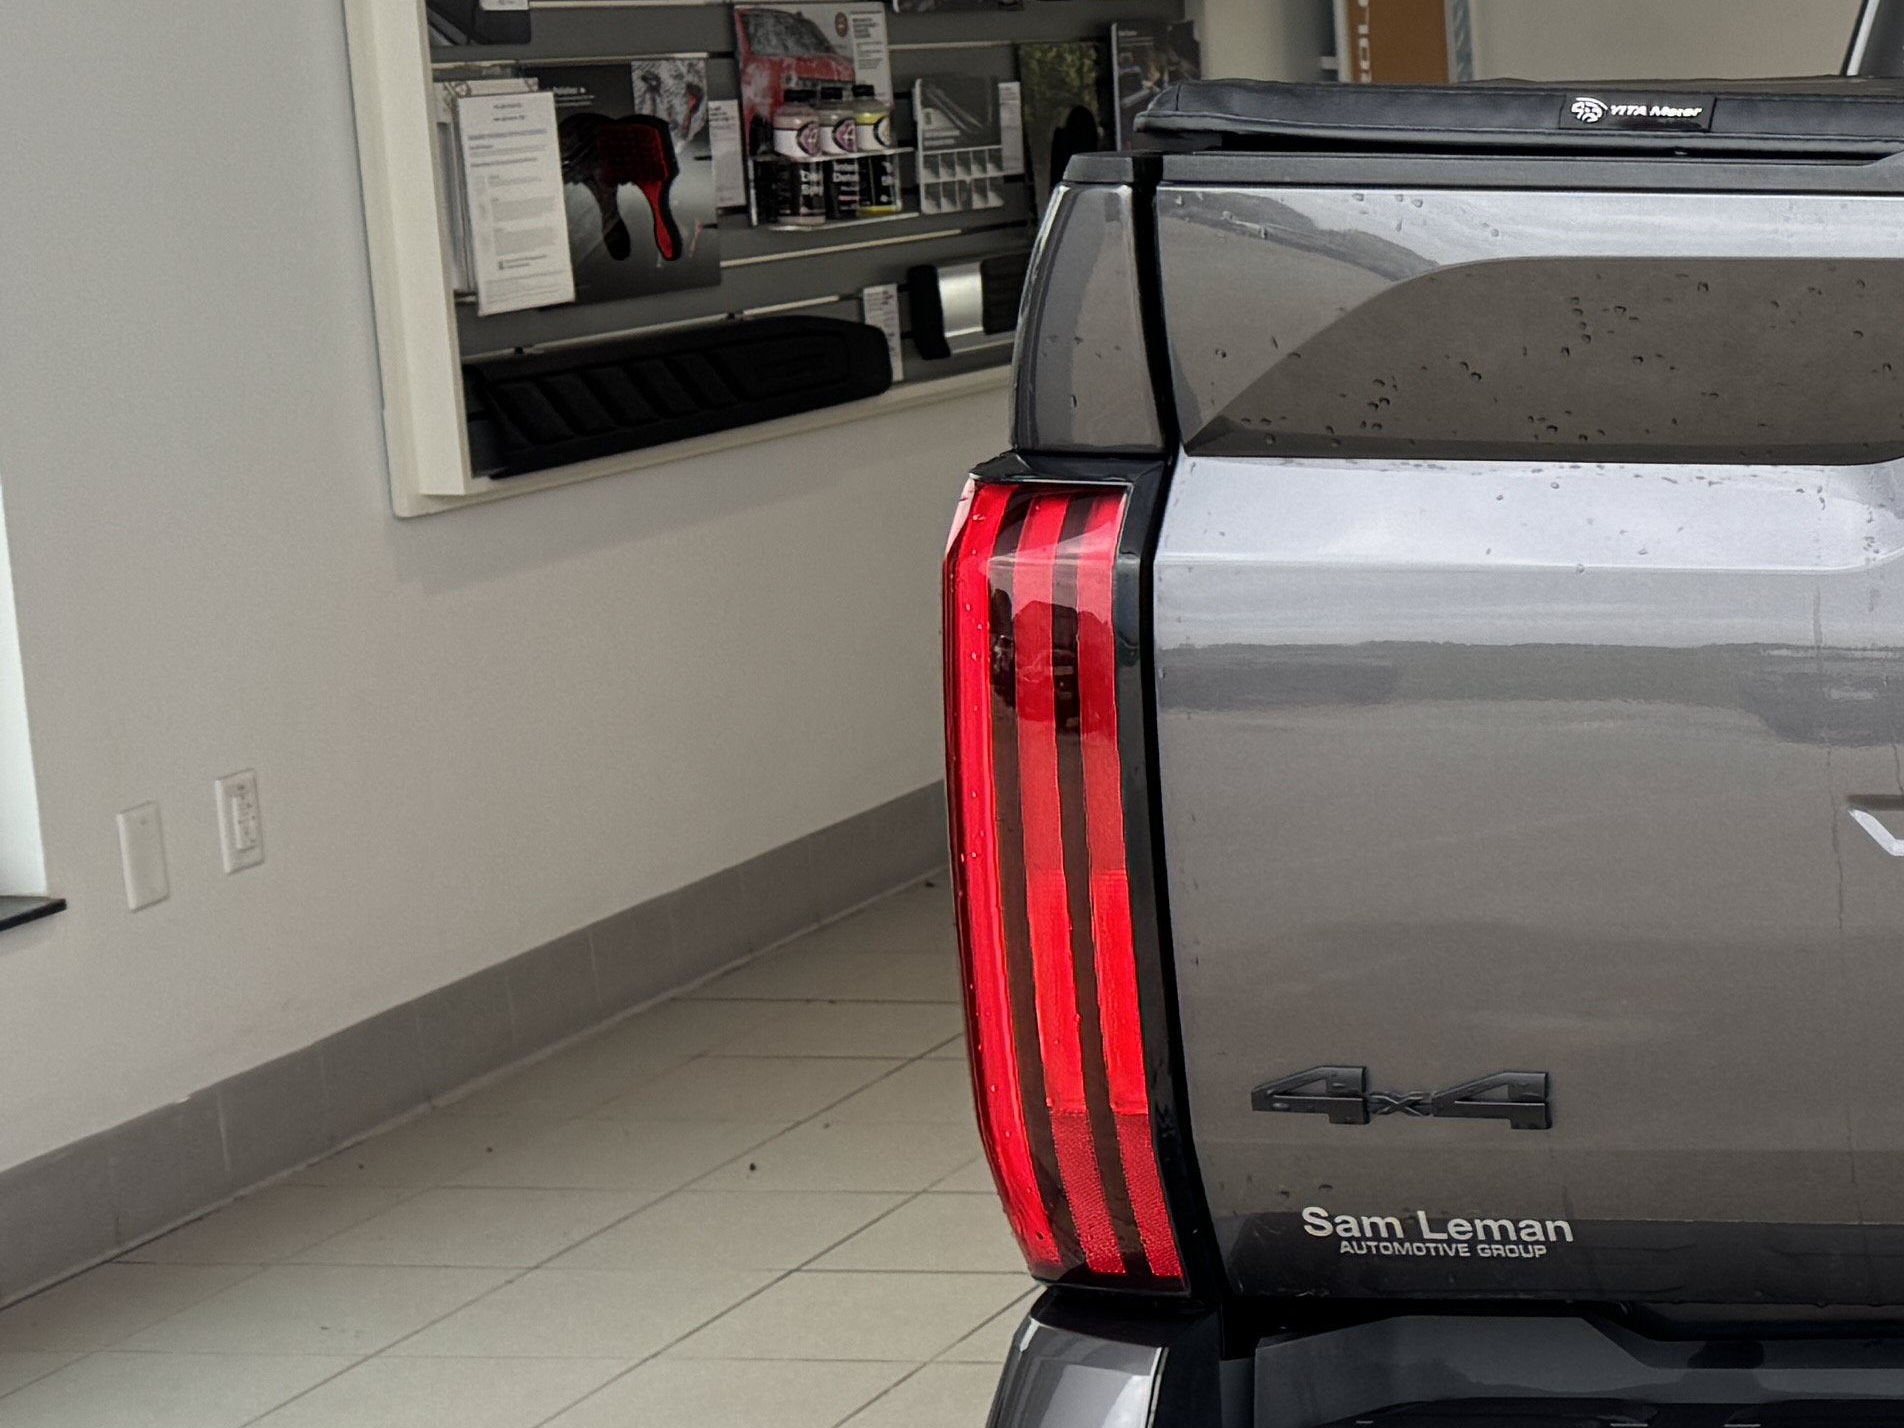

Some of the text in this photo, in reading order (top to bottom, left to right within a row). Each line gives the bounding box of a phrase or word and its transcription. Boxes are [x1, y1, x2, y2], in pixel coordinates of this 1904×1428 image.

[1301, 1206, 1575, 1243] Sam Leman
[1339, 1240, 1548, 1259] AUTOMOTIVE GROUP
